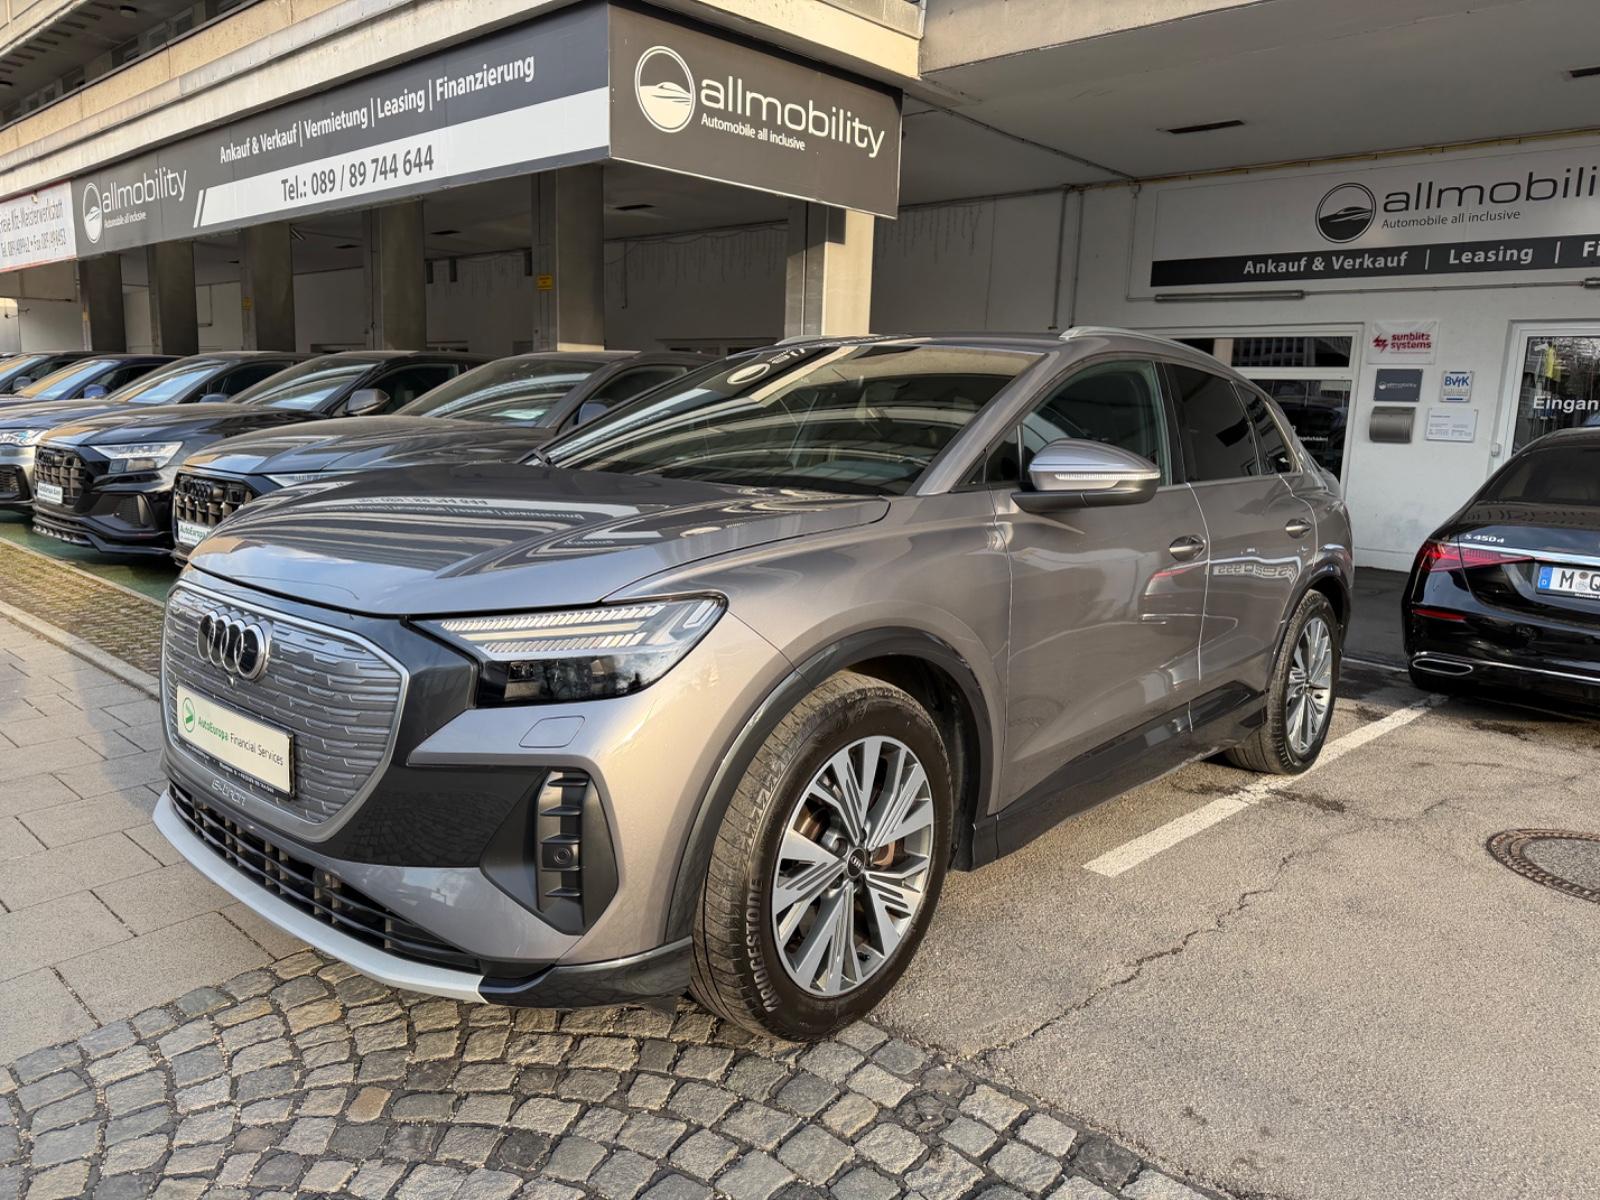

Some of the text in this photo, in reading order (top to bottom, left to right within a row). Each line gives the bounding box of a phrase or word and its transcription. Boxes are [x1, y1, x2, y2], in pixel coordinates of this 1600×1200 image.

[220, 55, 535, 164] Ankauf & Verkauf Vermietung Leasing Finanzierung
[700, 75, 885, 158] allmobility
[701, 113, 806, 150] Automobile all inclusive
[102, 167, 187, 213] allmobility
[281, 177, 307, 202] Tel.:
[311, 168, 336, 196] 089
[349, 163, 367, 188] 89
[371, 152, 399, 183] 744
[403, 144, 434, 177] 644
[1381, 209, 1521, 229] Automobile all inclusive
[1243, 256, 1307, 274] Ankauf
[1312, 257, 1325, 270] &
[1332, 251, 1409, 270] Verkauf
[1449, 246, 1534, 265] Leasing
[1390, 341, 1432, 350] systems
[1391, 332, 1431, 341] sunblitz
[1533, 395, 1599, 413] Eingan
[1559, 570, 1575, 589] M
[198, 717, 229, 741] AutoEuropa
[230, 732, 256, 754] Financial
[257, 744, 284, 766] Services
[745, 879, 780, 1013] BRIDGESTONE
